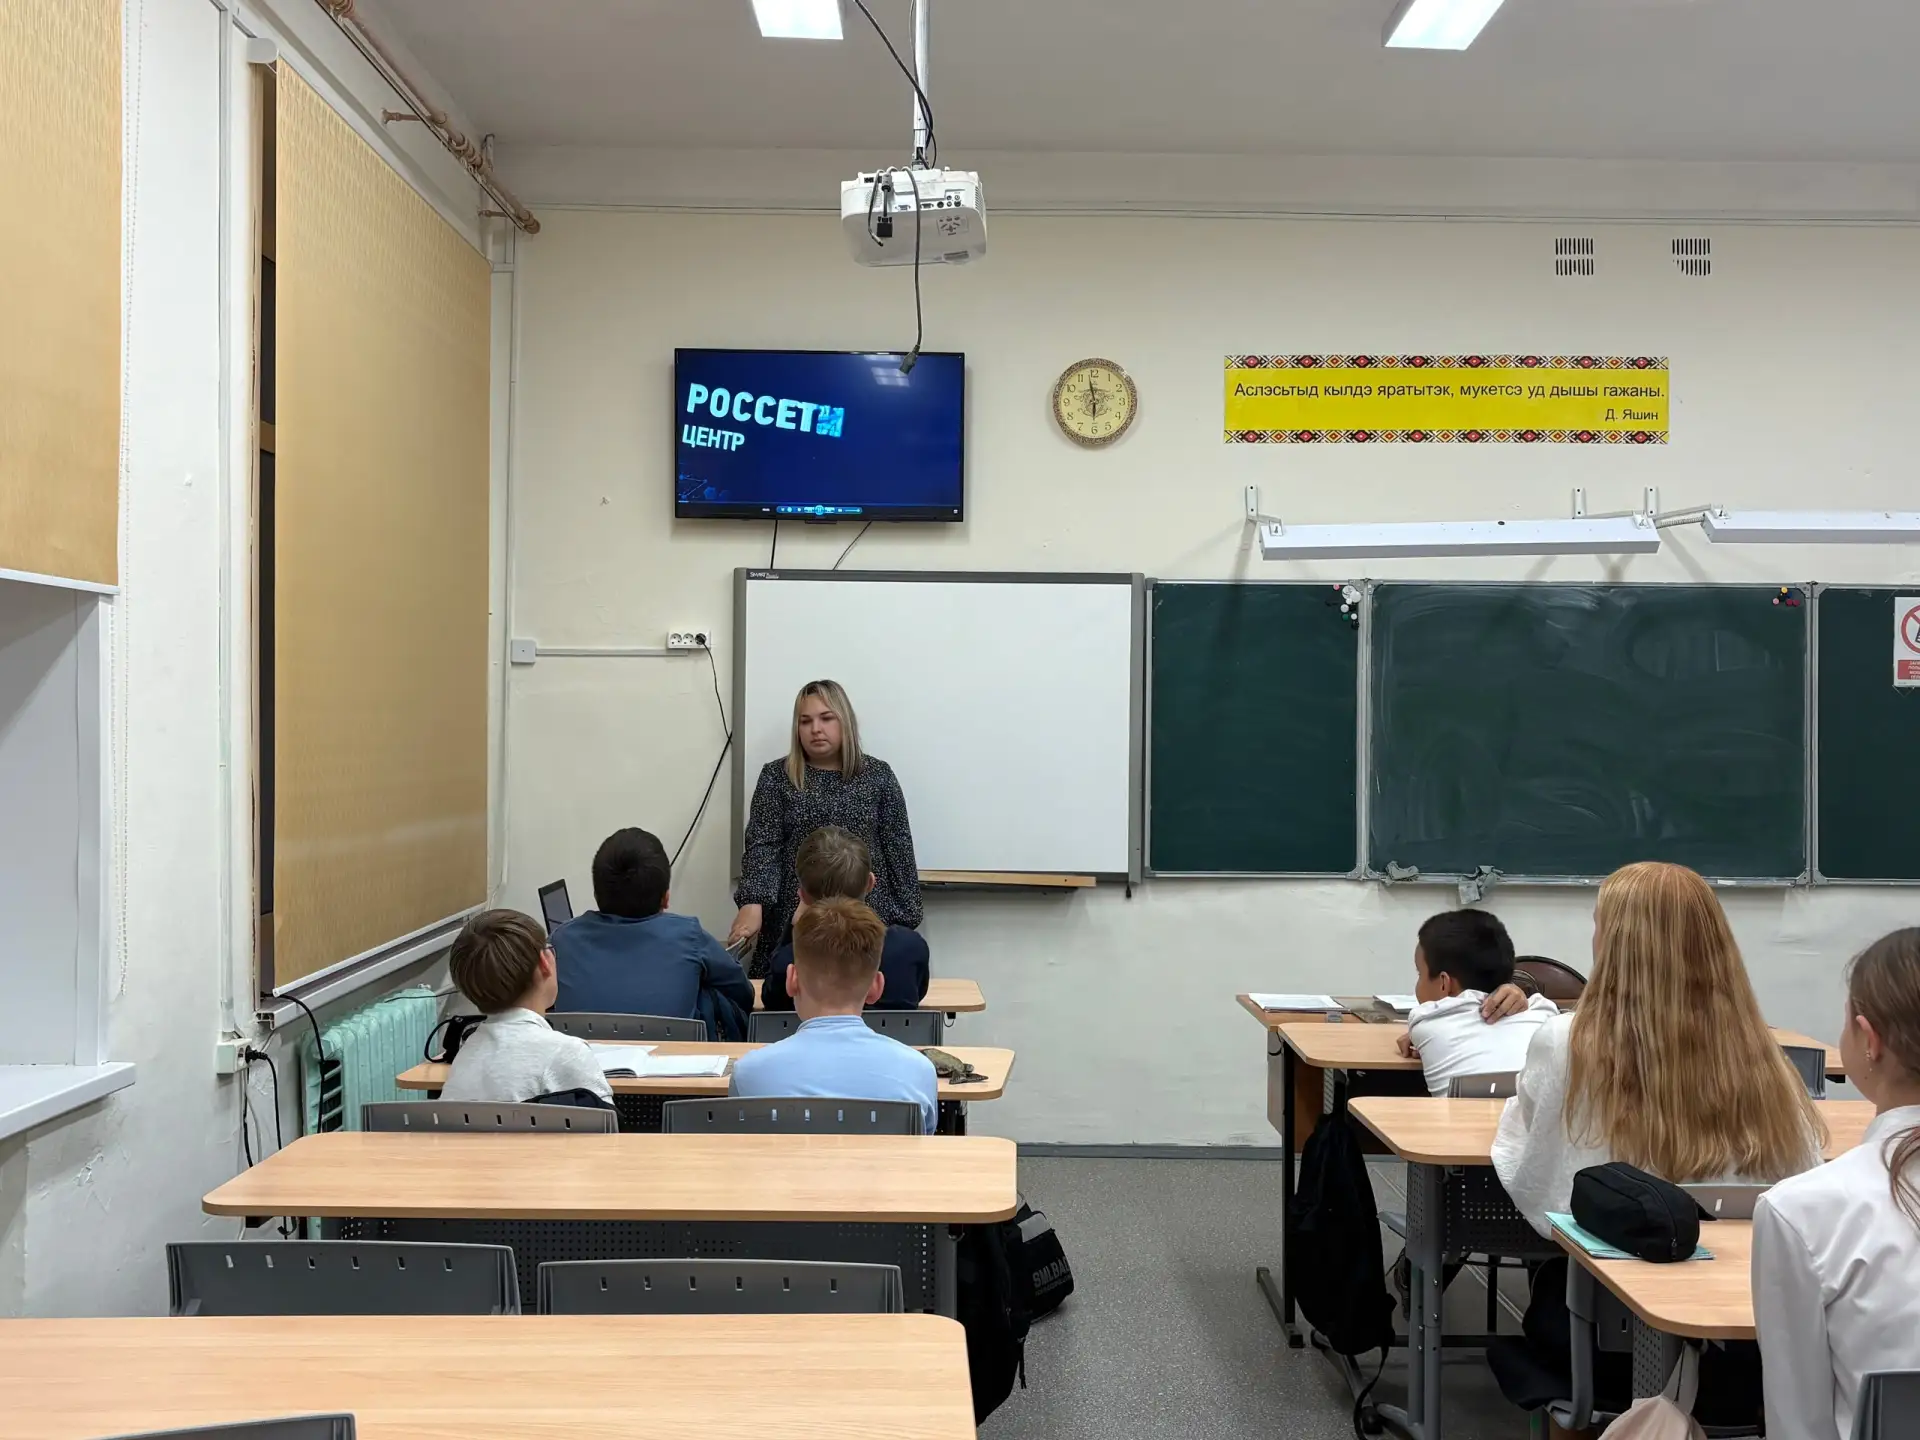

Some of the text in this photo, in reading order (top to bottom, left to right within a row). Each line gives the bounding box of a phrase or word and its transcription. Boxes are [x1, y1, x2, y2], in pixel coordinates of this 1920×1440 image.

[1077, 374, 1084, 382] 11
[1090, 369, 1099, 378] 12
[1066, 384, 1076, 393] 10
[1115, 383, 1123, 392] 2
[1234, 383, 1665, 399] Аслэсьтыд кылдэ яратытэк, мукетсэ уд дышы гажаны.
[1063, 398, 1070, 406] 9
[1118, 397, 1126, 406] 3
[1066, 412, 1074, 420] 8
[1115, 412, 1121, 420] 4
[1605, 408, 1659, 421] Д. Яшин
[1077, 422, 1083, 431] 7
[1091, 426, 1098, 434] 6
[1104, 422, 1112, 430] 5
[682, 424, 745, 451] ЦЕНТР
